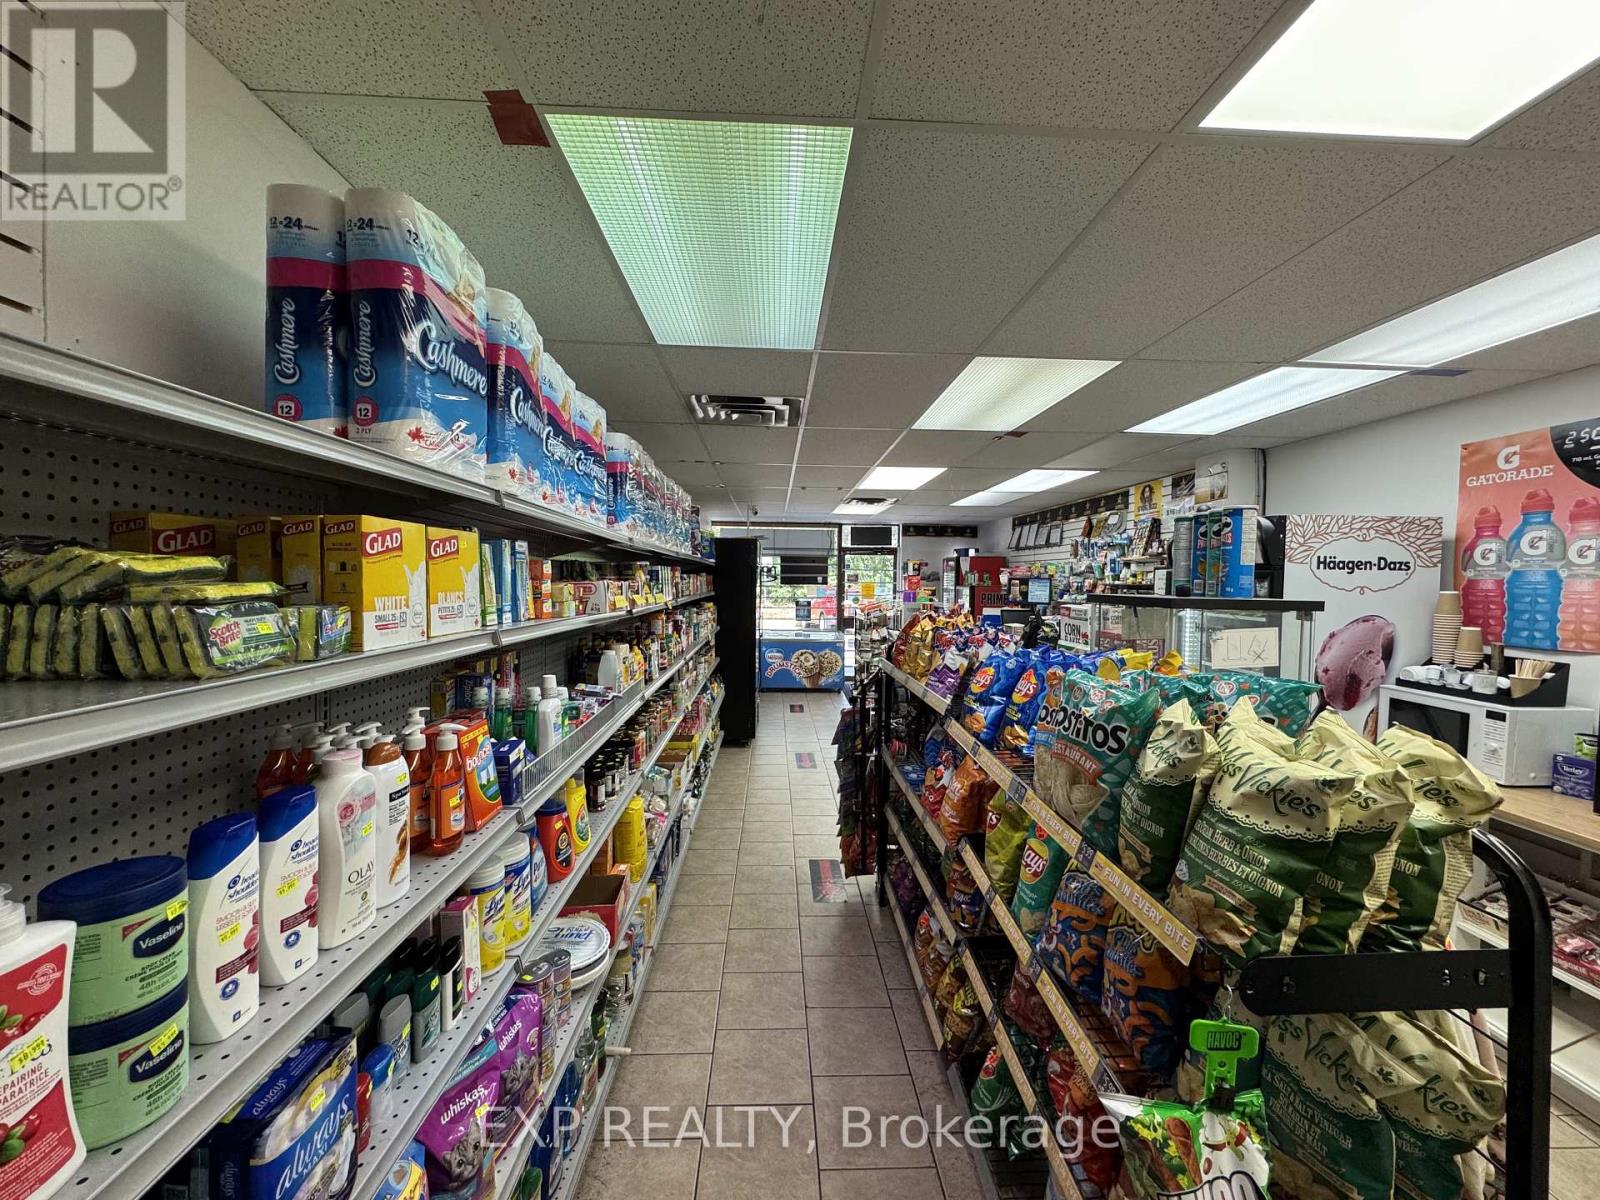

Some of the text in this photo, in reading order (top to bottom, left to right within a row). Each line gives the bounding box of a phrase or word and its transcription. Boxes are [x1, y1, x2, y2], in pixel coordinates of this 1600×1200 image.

[274, 297, 299, 385] Cashmere
[353, 300, 375, 387] Cashmere
[413, 322, 487, 397] Cashmere
[279, 404, 292, 417] 12
[358, 407, 370, 418] 12
[1496, 444, 1520, 470] G
[1466, 465, 1553, 487] GATORADE
[113, 520, 144, 533] GLAD
[238, 523, 264, 536] GLAD
[283, 522, 313, 535] GLAD
[325, 521, 354, 535] GLAD
[157, 530, 213, 553] GLAD
[365, 531, 402, 555] GLAD
[431, 538, 458, 558] GLAD
[1316, 555, 1411, 574] Häagen-Dazs
[374, 595, 407, 612] WHITE
[981, 593, 1008, 606] PRIME
[375, 614, 391, 623] SMALL
[1064, 622, 1081, 637] CORN
[219, 630, 241, 648] Brite
[466, 743, 491, 772] bounce
[1053, 742, 1097, 774] ESTAURANT
[1561, 765, 1584, 775] Tetley
[1232, 762, 1321, 818] Vickie's
[1046, 814, 1063, 834] EVERY
[1062, 830, 1079, 848] BITE
[1213, 829, 1236, 853] HERB
[1241, 844, 1271, 870] ONION
[1208, 847, 1240, 873] HERBES
[1236, 864, 1251, 880] ET
[1248, 870, 1285, 899] OIGNON
[1103, 867, 1121, 888] FUN
[1120, 882, 1131, 898] IN
[1131, 894, 1163, 925] EVERY
[1163, 921, 1191, 952] BITE
[139, 922, 183, 949] Vaseline
[493, 1008, 509, 1027] CONTROL
[499, 1019, 523, 1052] whiskas
[1062, 1012, 1080, 1041] EVERY
[1079, 1040, 1095, 1067] BITE
[1207, 1030, 1241, 1050] HAVOC
[136, 1039, 182, 1073] Vaseline
[252, 1077, 288, 1116] always
[440, 1082, 487, 1126] whiskas
[1313, 1108, 1353, 1151] VINEGAR
[275, 1093, 351, 1200] always
[302, 1141, 329, 1178] MAXI
